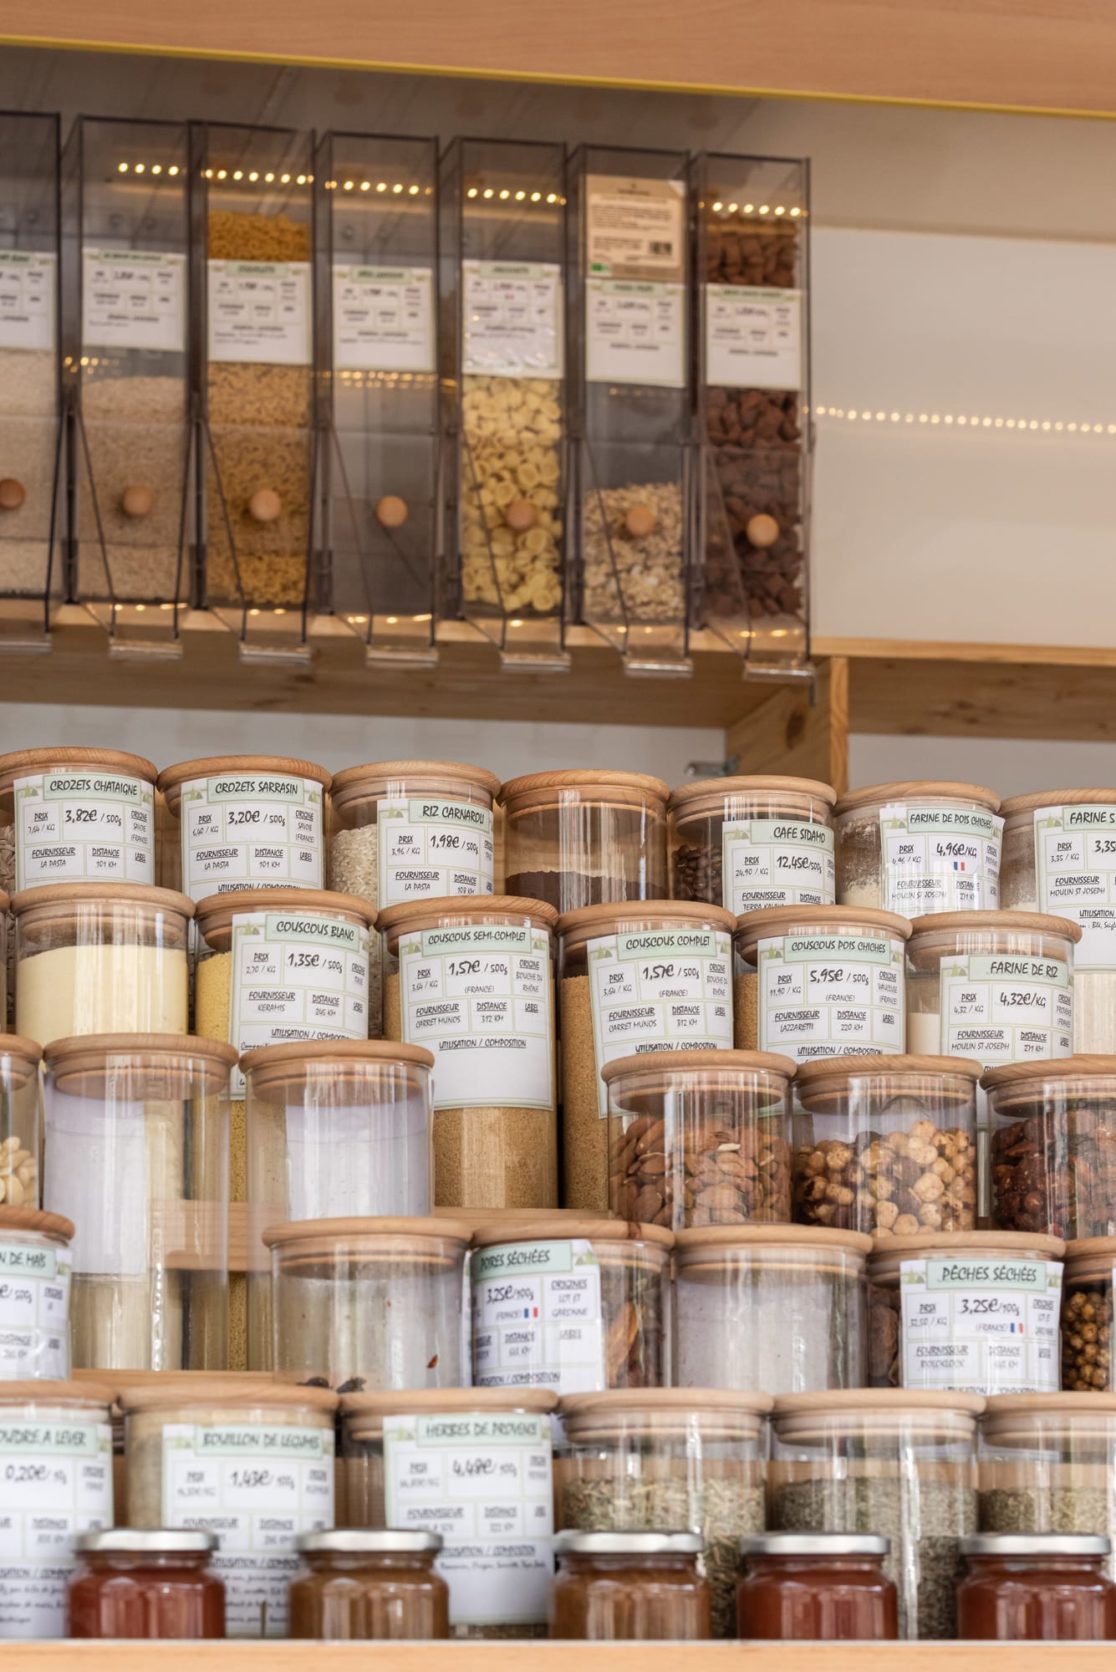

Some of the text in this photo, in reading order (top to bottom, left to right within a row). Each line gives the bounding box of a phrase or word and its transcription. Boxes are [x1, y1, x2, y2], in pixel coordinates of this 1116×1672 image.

[50, 780, 138, 796] CROZETS CHATAIGNE
[215, 781, 298, 795] CROZETS SARRASIN
[423, 805, 439, 817] RIZ
[65, 809, 97, 823] 3,82€
[106, 815, 122, 827] 500g
[228, 810, 260, 825] 3,20€
[269, 815, 286, 827] 500g
[910, 813, 939, 824] FARINE
[942, 813, 952, 823] DE
[955, 814, 970, 825] POIS
[1070, 812, 1106, 824] FARINE
[773, 827, 825, 843] CAFE SIDAMO
[430, 834, 460, 849] 1,98€
[466, 842, 478, 855] 500g
[32, 848, 75, 859] FOURNISSEUR
[92, 848, 120, 859] DISTANCE
[196, 849, 238, 861] FOURNISSEUR
[254, 848, 283, 858] DISTANCE
[49, 860, 66, 868] PASTA
[212, 861, 229, 869] PASTA
[395, 871, 440, 880] FOURNISSEUR
[454, 874, 477, 886] DISTANCE
[1055, 876, 1100, 887] FOURNISSEUR
[742, 891, 786, 901] FOURNISSEUR
[1050, 888, 1074, 897] MOULIN
[1082, 888, 1105, 896] JOSEPH
[276, 921, 355, 941] COUSCOUS BLANC
[428, 932, 526, 945] COUSCOUS SEMI-COMPLET
[626, 936, 711, 950] COUSCOUS COMPLET
[791, 940, 886, 953] COUSCOUS POIS CHICHES
[288, 953, 320, 967] 1,35€
[328, 960, 343, 974] 500g
[449, 960, 481, 976] 1,57€
[490, 964, 508, 975] 500g
[990, 961, 1058, 978] FARINE DE RIZ
[642, 964, 674, 980] 1,57€
[683, 968, 699, 979] 500g
[810, 969, 843, 983] 5,95€
[852, 974, 869, 985] 500g
[248, 991, 296, 1001] FOURNISSEUR
[312, 994, 340, 1007] DISTANCE
[416, 1004, 460, 1017] FOURNISSEUR
[476, 1002, 507, 1012] DISTANCE
[672, 1006, 700, 1015] DISTANCE
[609, 1007, 655, 1022] FOURNISSEUR
[775, 1010, 820, 1022] FOURNISSEUR
[837, 1011, 866, 1021] DISTANCE
[271, 1028, 310, 1039] UTILISATION
[957, 1030, 1004, 1040] FOURNISSEUR
[1020, 1031, 1047, 1043] DISTANCE
[439, 1039, 477, 1051] UTILISATION
[484, 1038, 526, 1049] COMPOSITION
[635, 1043, 673, 1055] UTILISATION
[952, 1042, 976, 1050] MOULIN
[984, 1042, 1009, 1050] JOSEPH
[797, 1046, 835, 1057] UTILISATION
[507, 1249, 551, 1266] SÉCHÉES
[942, 1264, 1036, 1282] PÊCHES SÉCHÉES
